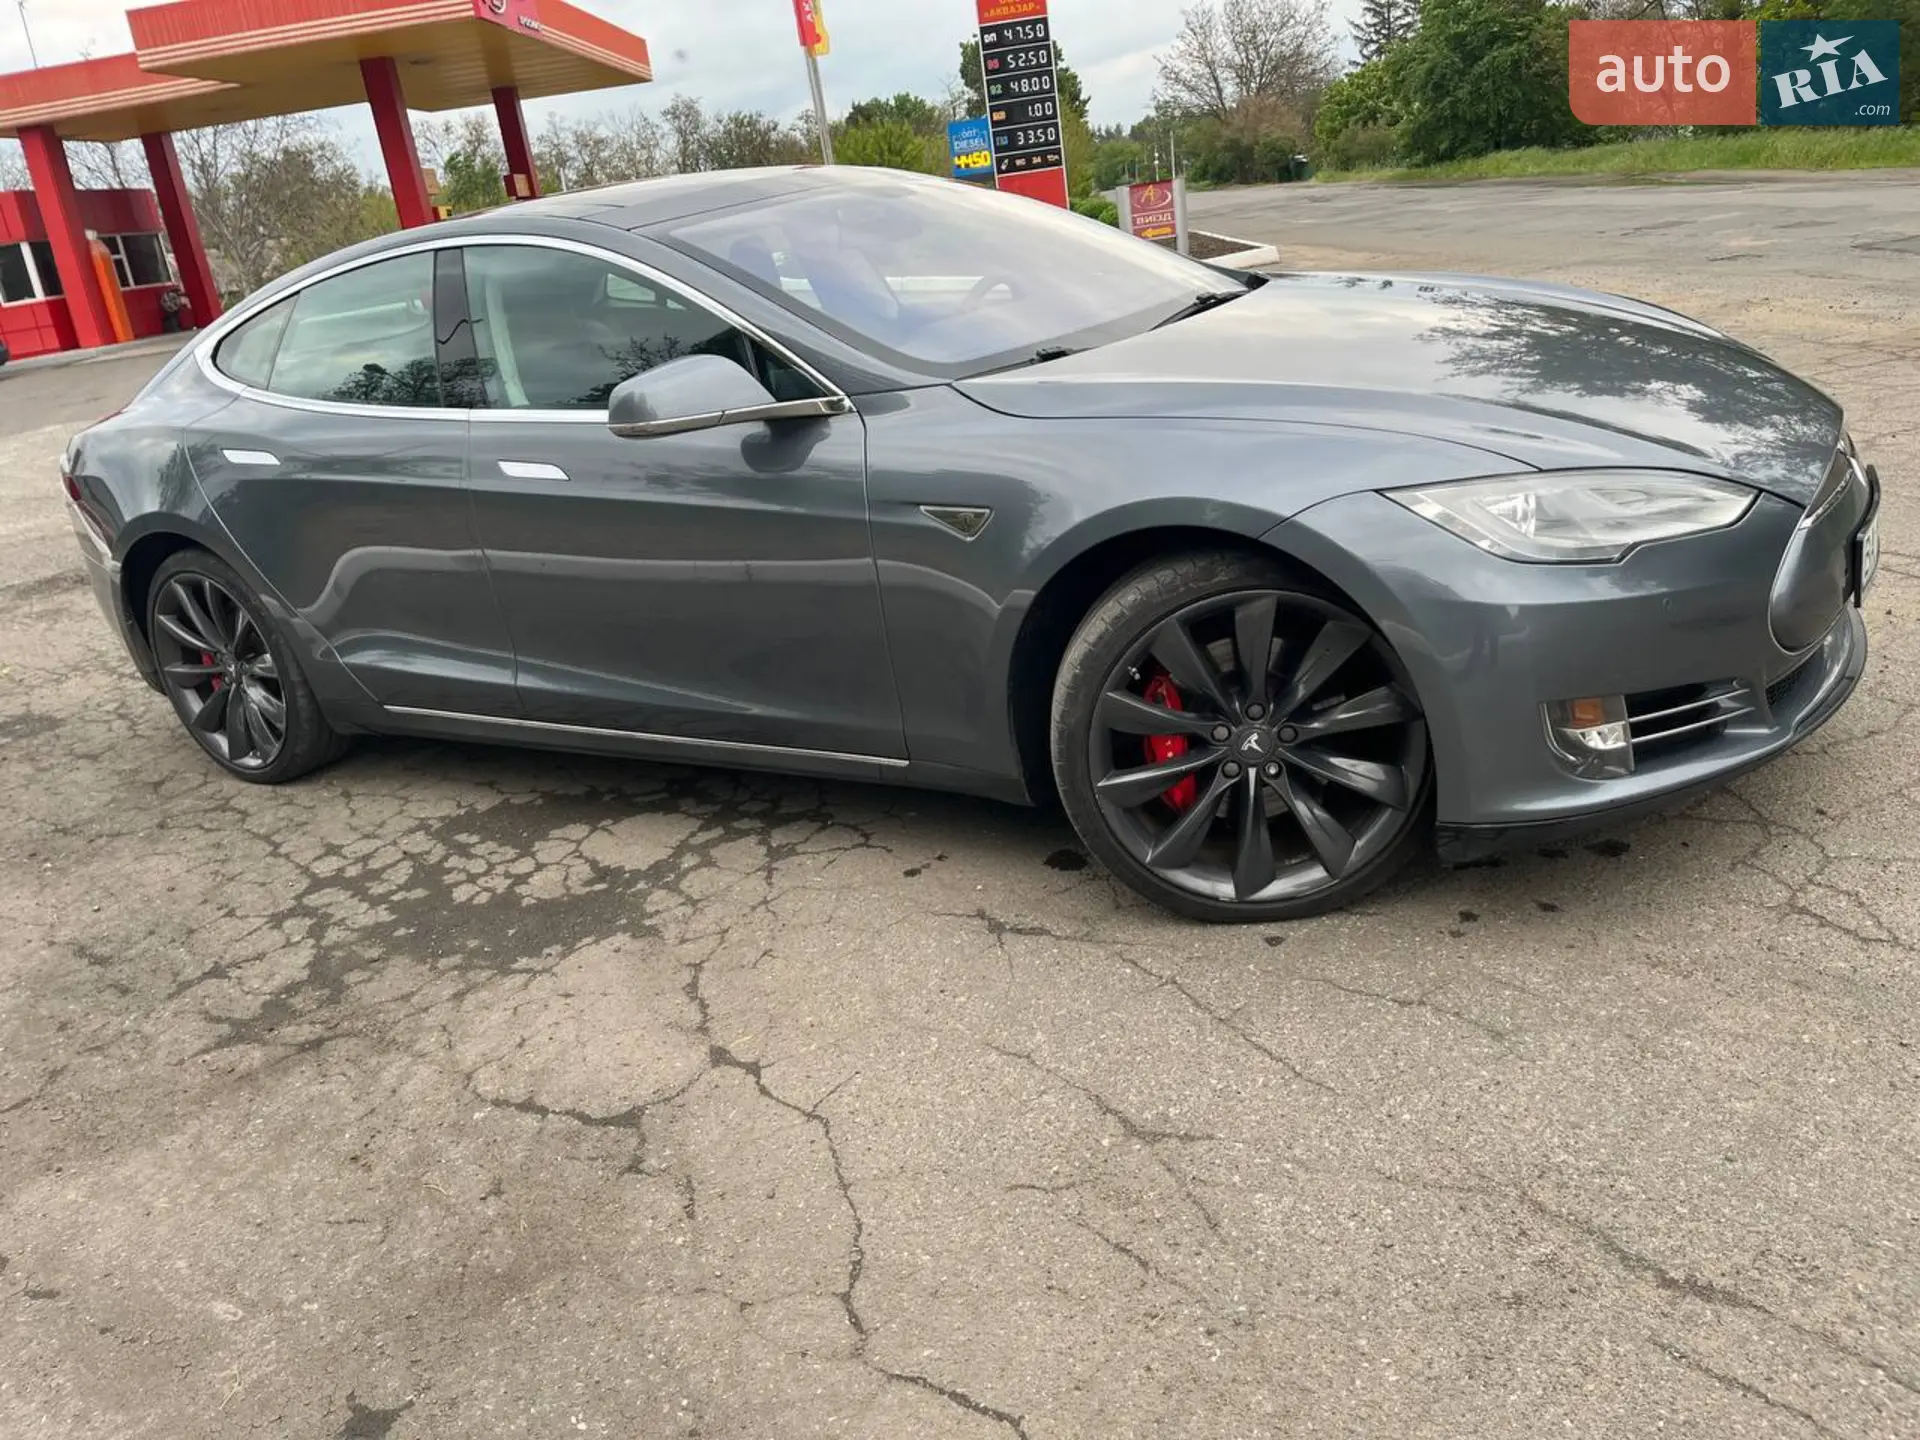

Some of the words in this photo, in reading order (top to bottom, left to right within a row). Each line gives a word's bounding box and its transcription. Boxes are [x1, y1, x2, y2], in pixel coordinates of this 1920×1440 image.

[1004, 24, 1045, 40] 47.50
[1007, 50, 1048, 69] 52.50
[1010, 75, 1050, 94] 48.00
[1028, 101, 1053, 118] 1.00
[1016, 127, 1056, 145] 33.50
